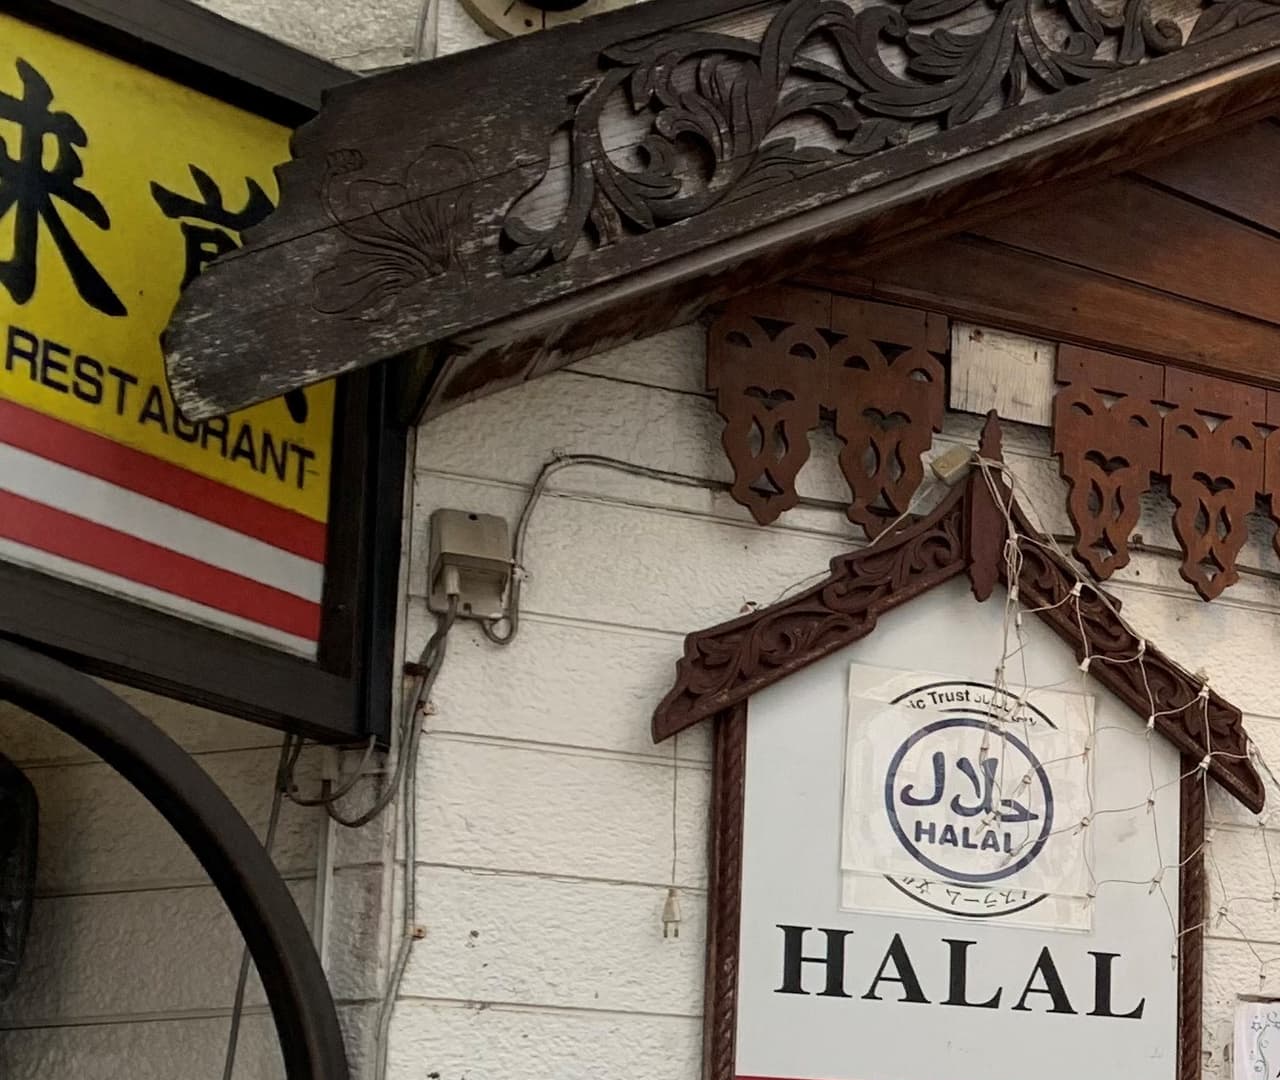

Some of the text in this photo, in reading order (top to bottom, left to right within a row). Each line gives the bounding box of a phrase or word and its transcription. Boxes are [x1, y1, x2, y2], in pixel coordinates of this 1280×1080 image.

[928, 689, 971, 705] Trust
[913, 820, 1018, 854] HALAL
[773, 923, 1147, 1021] HALAL
